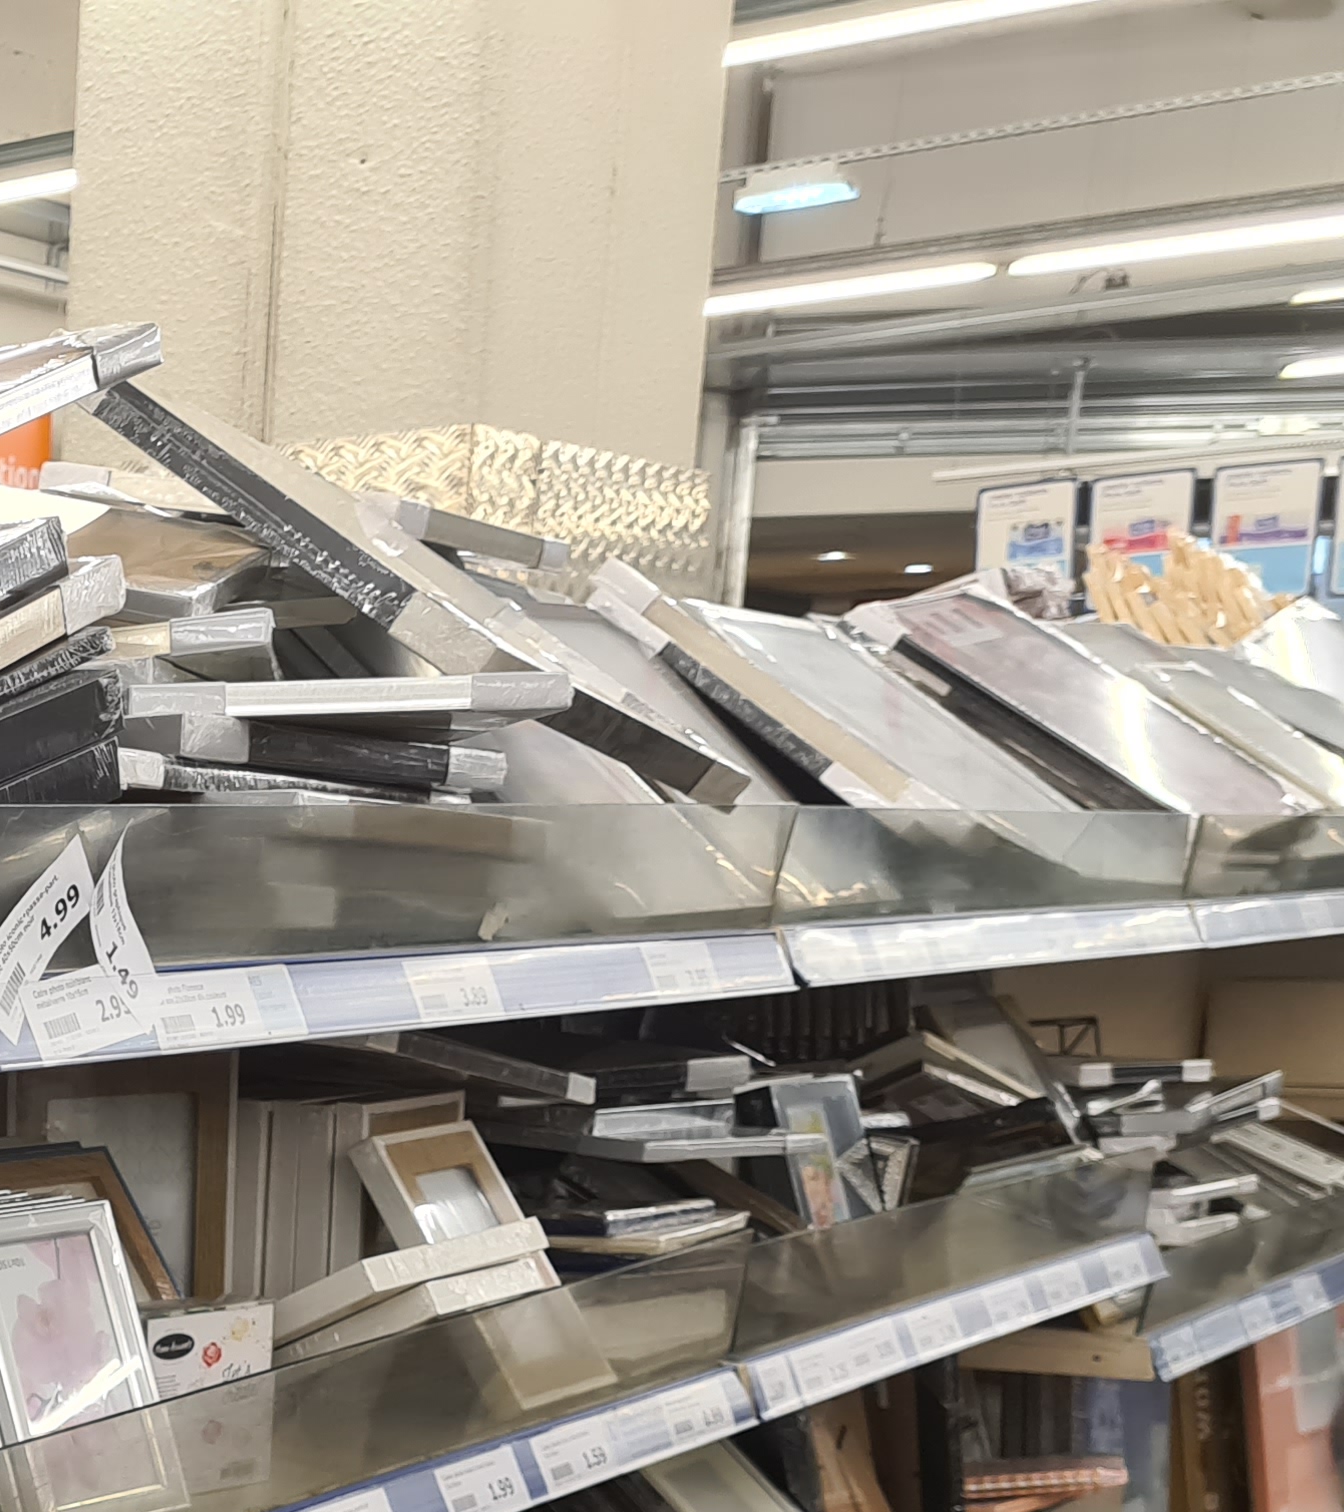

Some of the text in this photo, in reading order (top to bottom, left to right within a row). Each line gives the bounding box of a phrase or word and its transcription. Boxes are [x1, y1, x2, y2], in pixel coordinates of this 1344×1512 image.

[39, 884, 80, 941] 4.99
[105, 941, 139, 1000] 1.49
[211, 1003, 247, 1029] 1.99
[487, 1475, 516, 1502] 1.99
